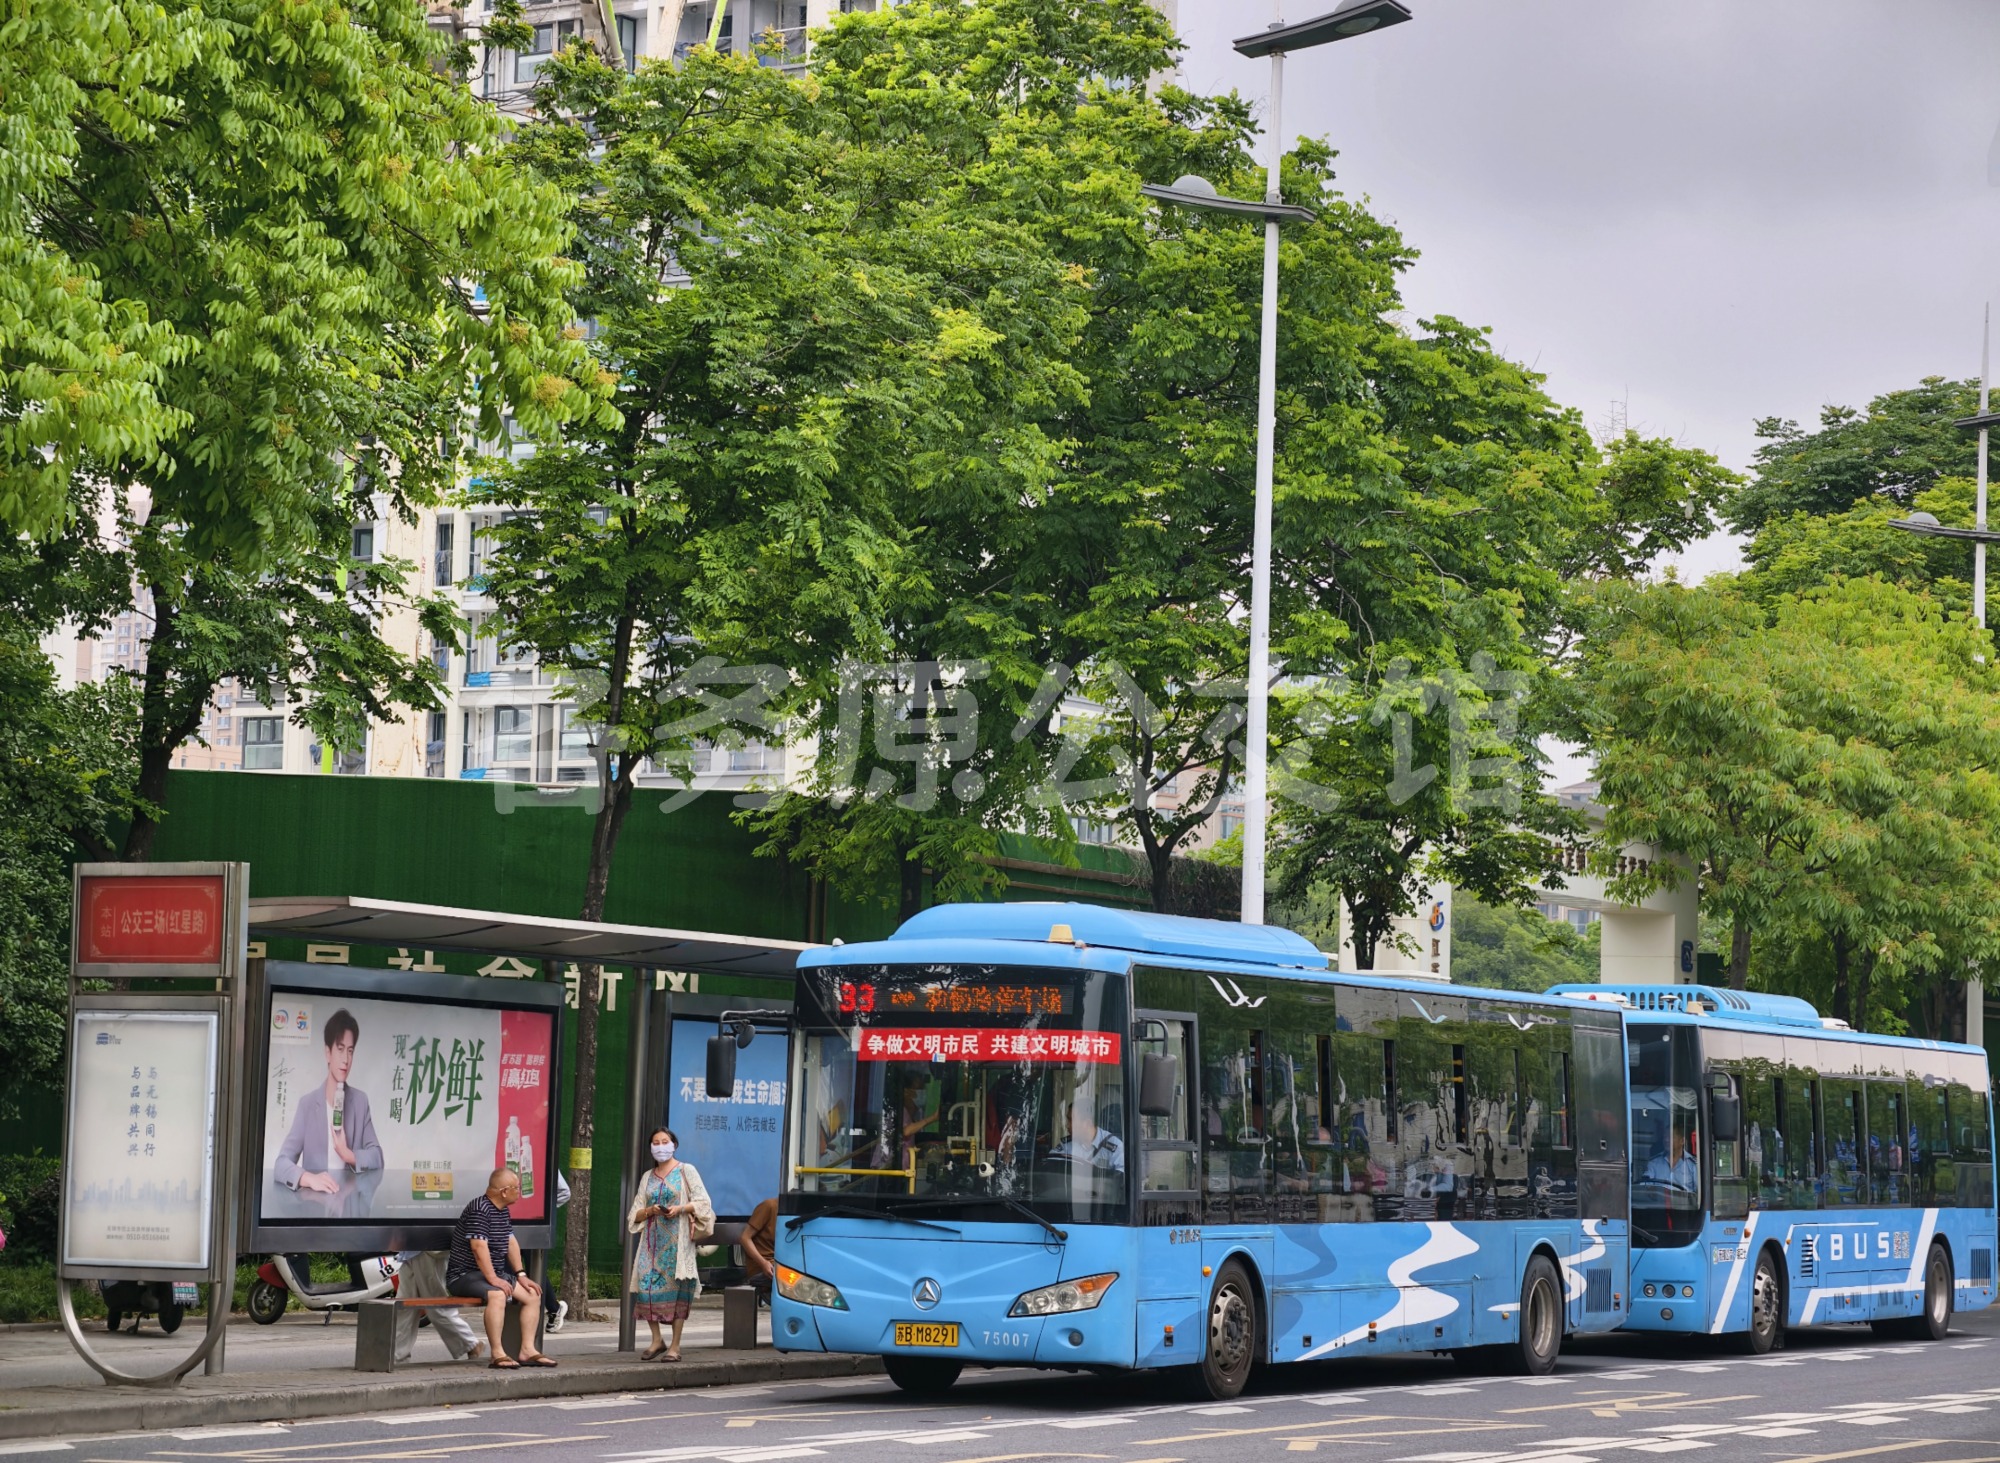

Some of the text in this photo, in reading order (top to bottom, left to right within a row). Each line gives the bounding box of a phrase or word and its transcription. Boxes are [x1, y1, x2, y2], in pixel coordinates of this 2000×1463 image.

[101, 906, 113, 938] 本站
[120, 909, 208, 935] 公交三场(红星路)
[840, 983, 875, 1013] 33
[867, 1034, 1112, 1057] 争做文明市民 共建文明城市
[404, 1036, 486, 1127] 秒鲜
[144, 1066, 159, 1157] 与无锡同行
[379, 1264, 395, 1279] 18
[983, 1331, 1030, 1347] 75007
